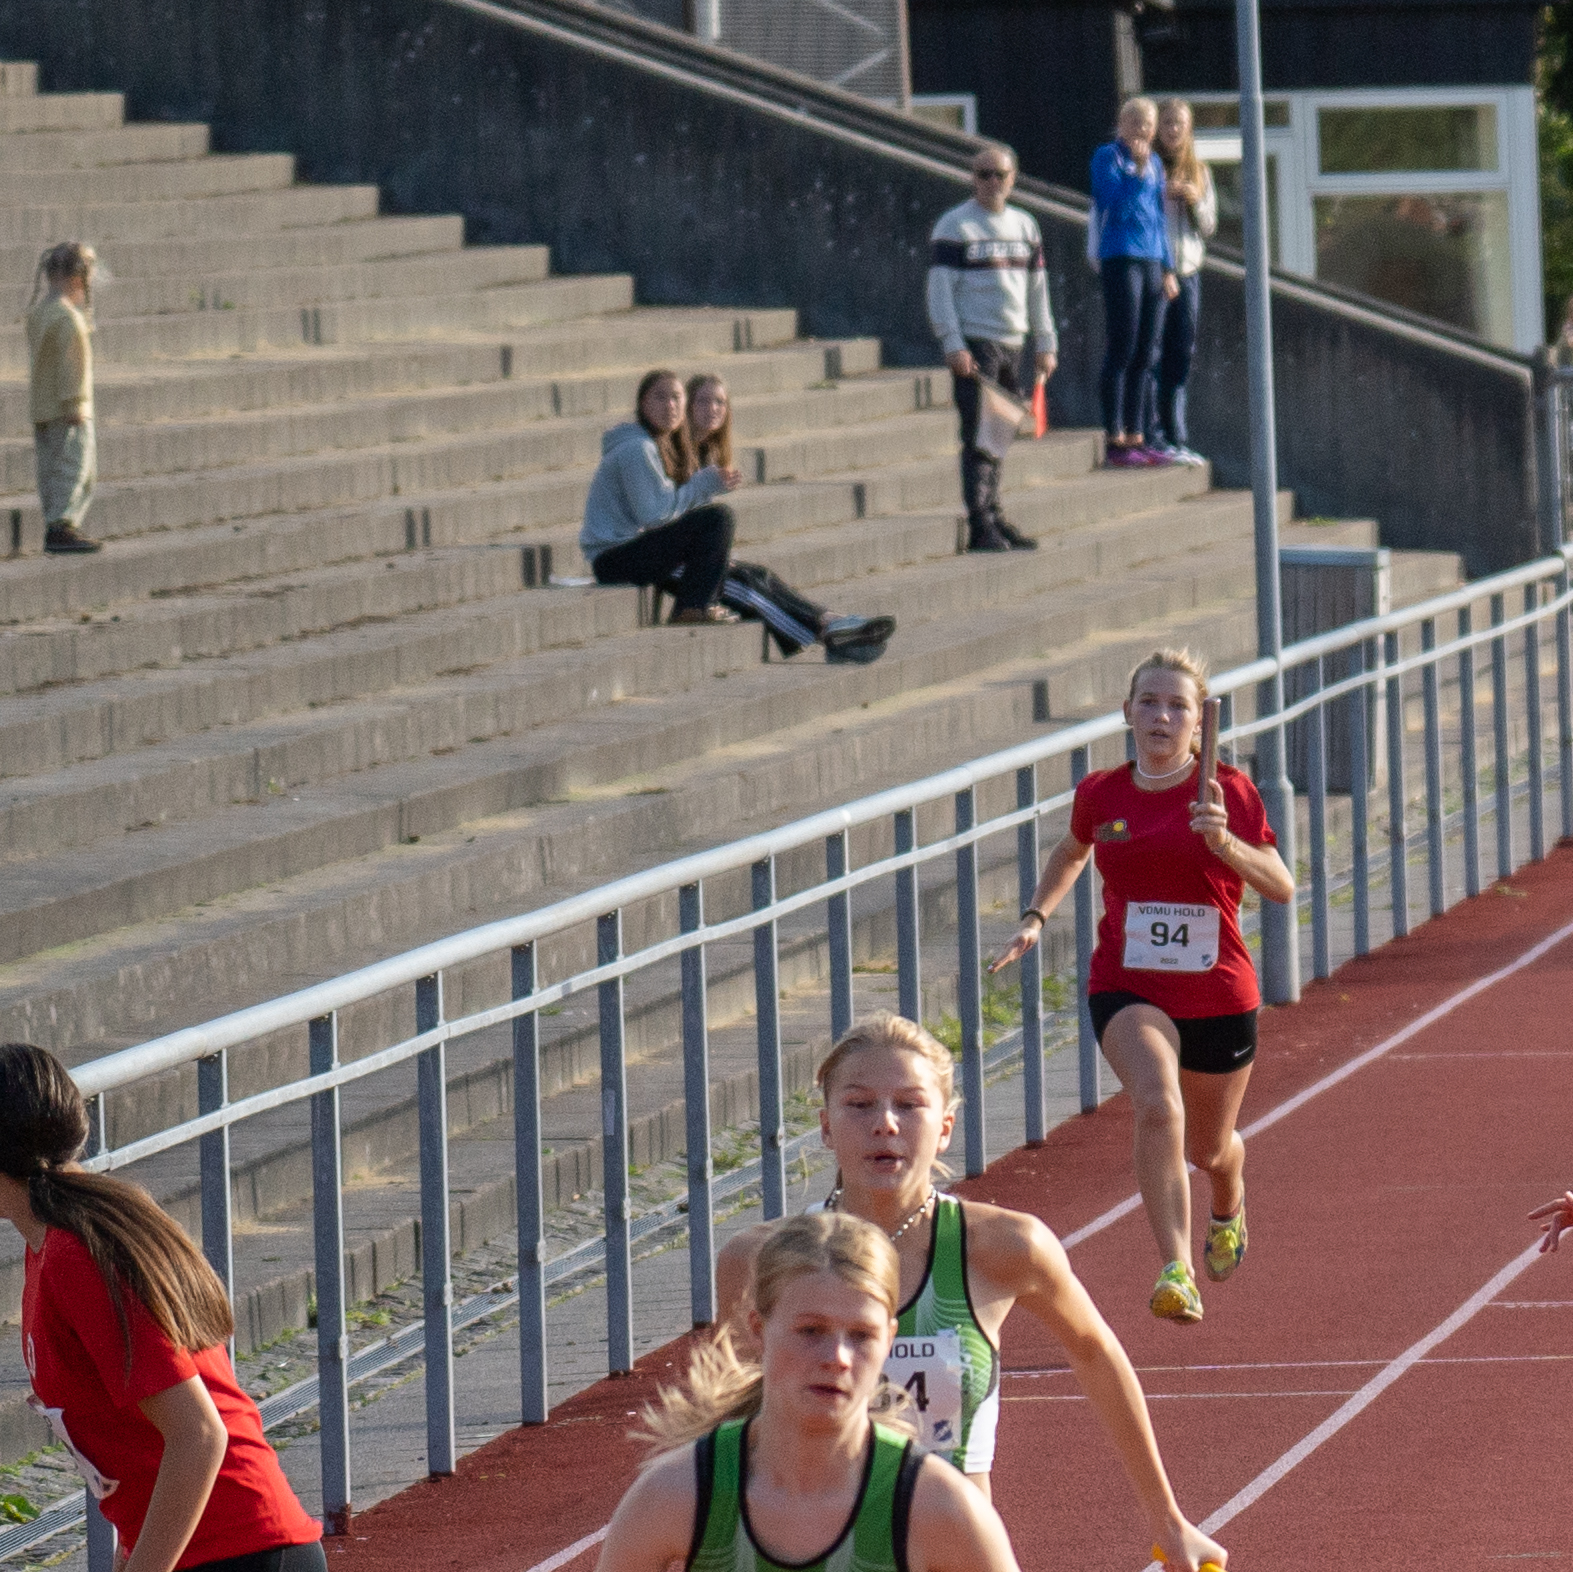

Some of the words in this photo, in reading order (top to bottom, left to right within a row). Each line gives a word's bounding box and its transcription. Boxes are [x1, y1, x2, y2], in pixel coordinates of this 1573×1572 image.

[1138, 906, 1172, 917] VDMU
[1173, 908, 1206, 918] HOLD
[1150, 921, 1190, 948] 94
[1160, 957, 1179, 966] 2022
